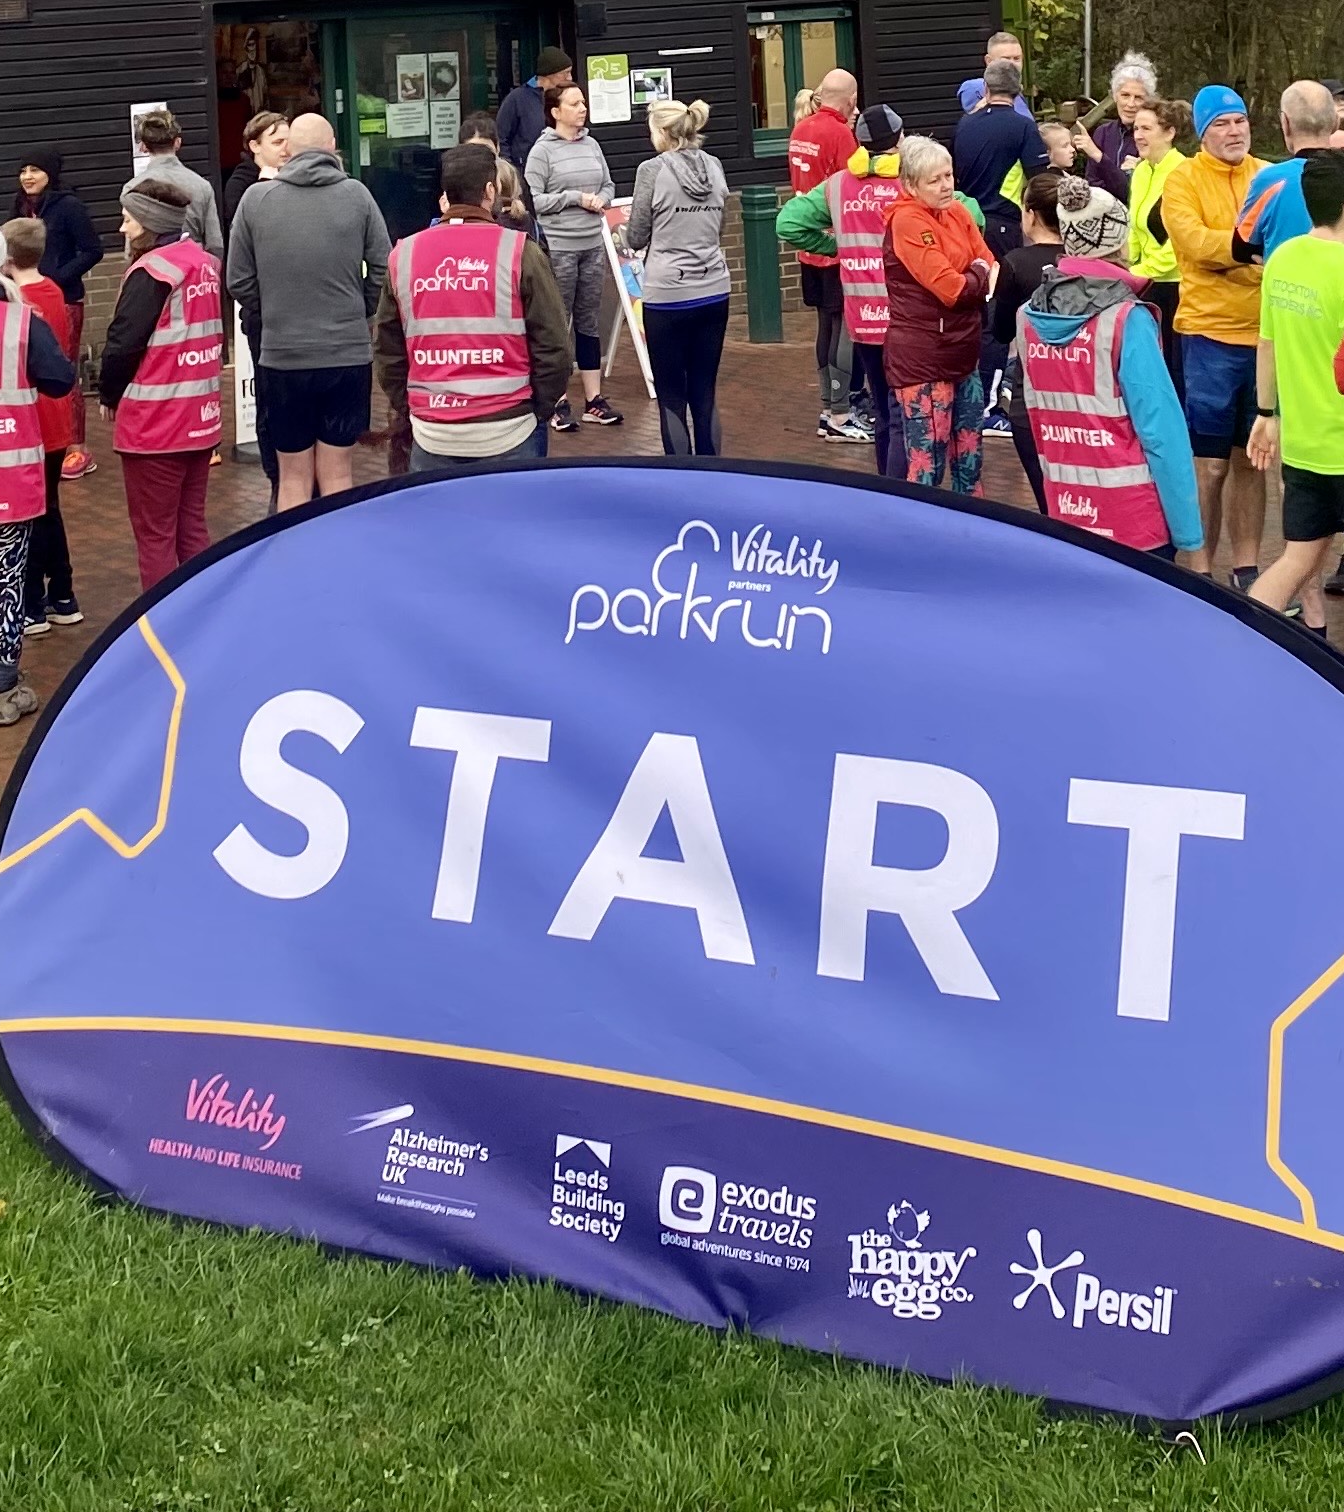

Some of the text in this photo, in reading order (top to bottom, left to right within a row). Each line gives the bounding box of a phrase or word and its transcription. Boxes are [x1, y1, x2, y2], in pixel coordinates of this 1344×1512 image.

[413, 266, 489, 298] parkrun
[413, 347, 505, 366] OLUNTEER
[1057, 490, 1099, 525] Vitality
[731, 523, 840, 595] Vitality
[564, 556, 833, 655] parkrun
[727, 579, 772, 592] partners
[211, 688, 1248, 1024] START
[185, 1072, 287, 1151] Vitality
[148, 1137, 304, 1180] HEALTH AND LIFE INSURANCE
[385, 1145, 466, 1177] Research
[389, 1127, 490, 1162] Alzheimer's
[381, 1163, 408, 1185] UK
[553, 1161, 609, 1191] Leeds
[552, 1183, 626, 1222] Building
[721, 1181, 817, 1221] exodus
[548, 1204, 623, 1244] Society
[717, 1205, 814, 1250] travels
[861, 1228, 892, 1248] the
[660, 1230, 811, 1273] global adventures since 1974
[847, 1233, 978, 1287] happy
[871, 1278, 976, 1321] egg co.
[1071, 1272, 1173, 1336] Persil
